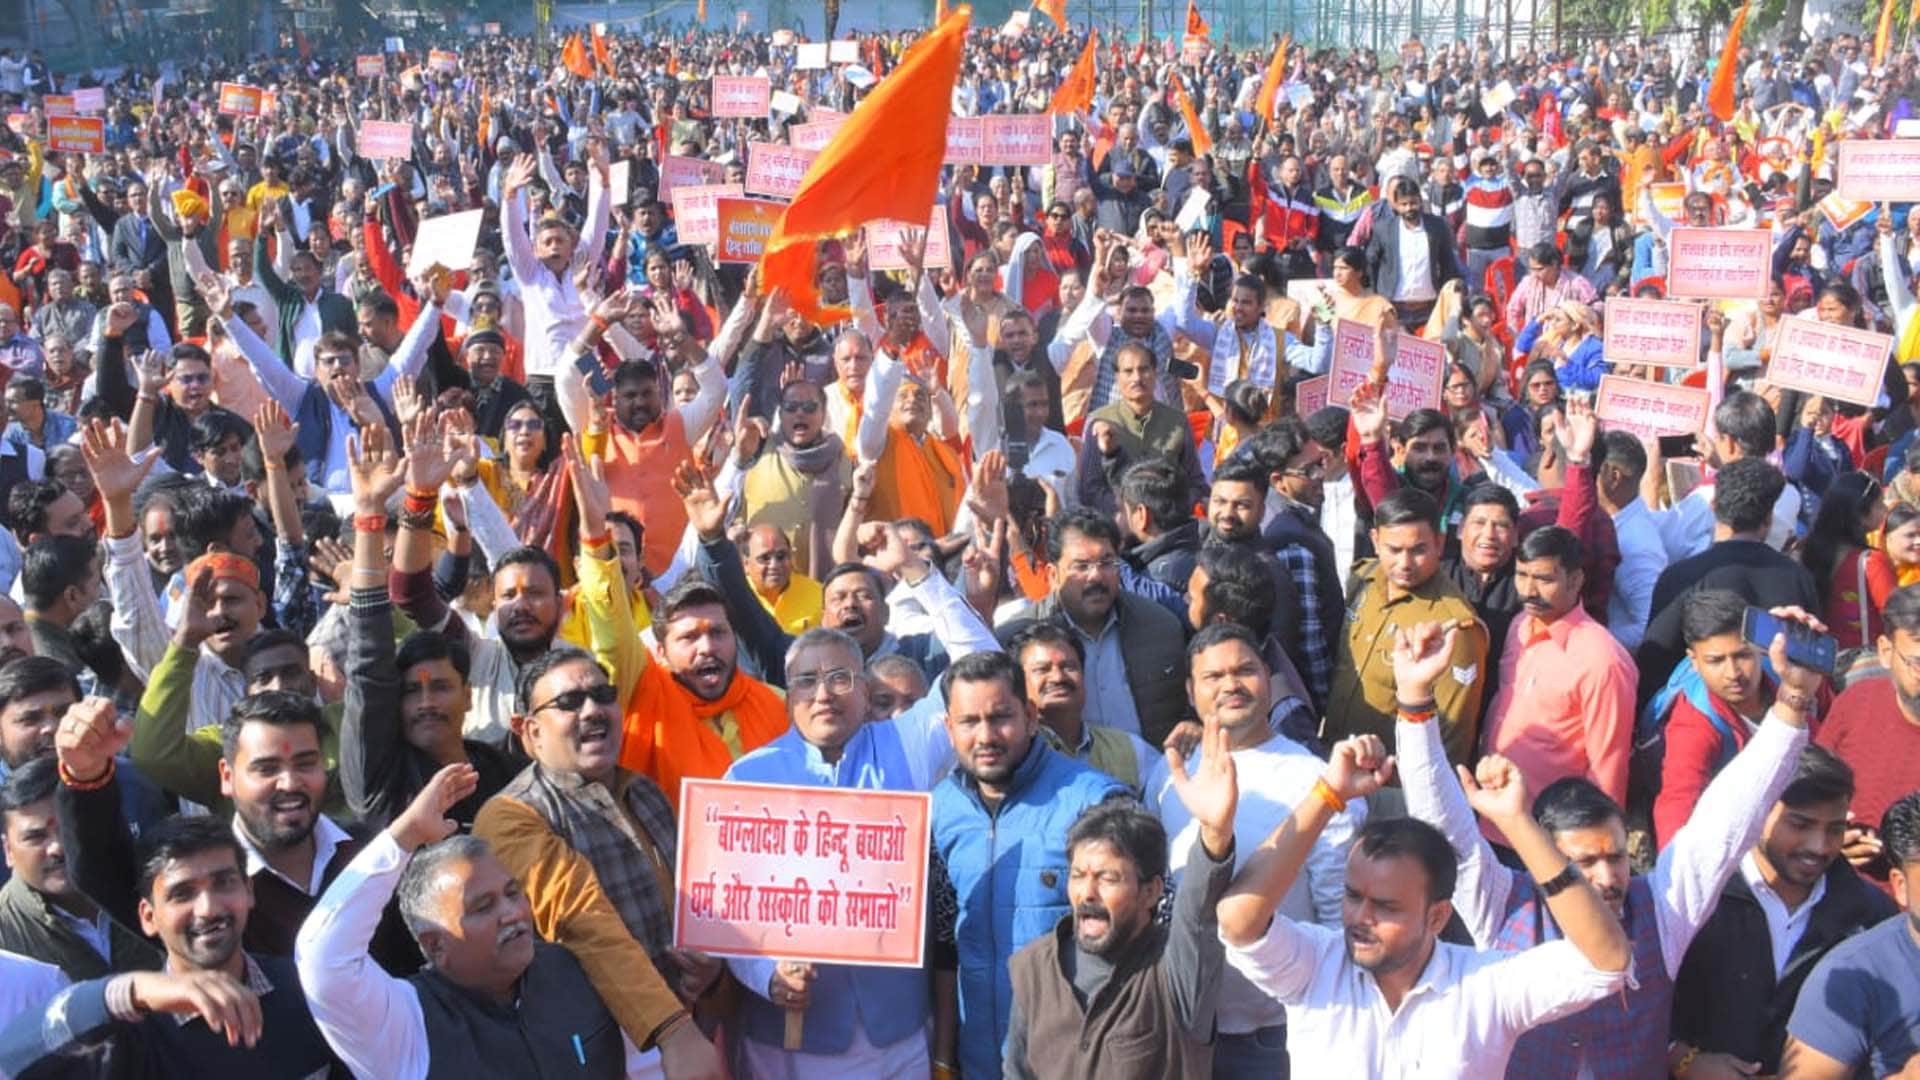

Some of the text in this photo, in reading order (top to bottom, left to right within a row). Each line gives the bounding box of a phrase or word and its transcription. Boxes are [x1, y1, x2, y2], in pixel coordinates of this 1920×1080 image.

[793, 810, 810, 857] के
[816, 811, 850, 873] हिन्दू
[856, 815, 906, 861] बचाओ
[721, 873, 752, 921] और
[757, 875, 811, 936] संस्कृति
[818, 880, 840, 926] को
